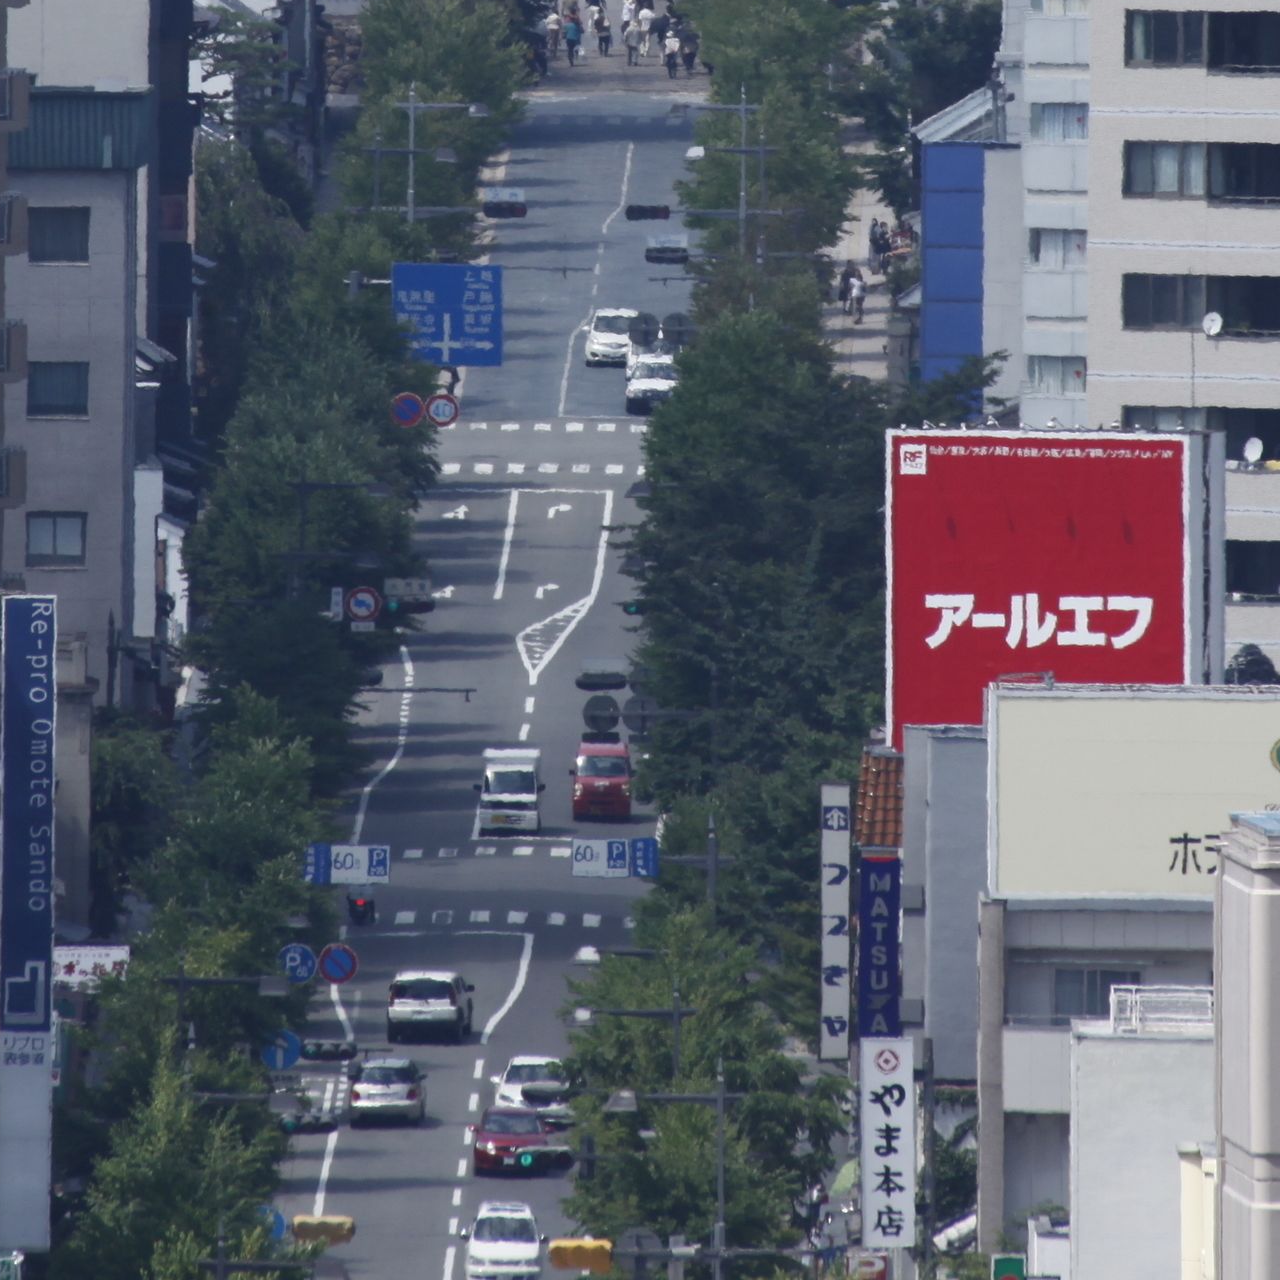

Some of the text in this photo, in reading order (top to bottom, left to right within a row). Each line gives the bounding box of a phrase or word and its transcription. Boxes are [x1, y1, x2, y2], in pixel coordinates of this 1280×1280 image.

[26, 601, 53, 704] Re-pro
[924, 592, 1154, 650] アールエフ
[28, 717, 53, 809] Omote
[28, 825, 53, 912] Sando
[869, 871, 891, 1034] MATSUYA
[869, 1084, 907, 1239] やま本店
